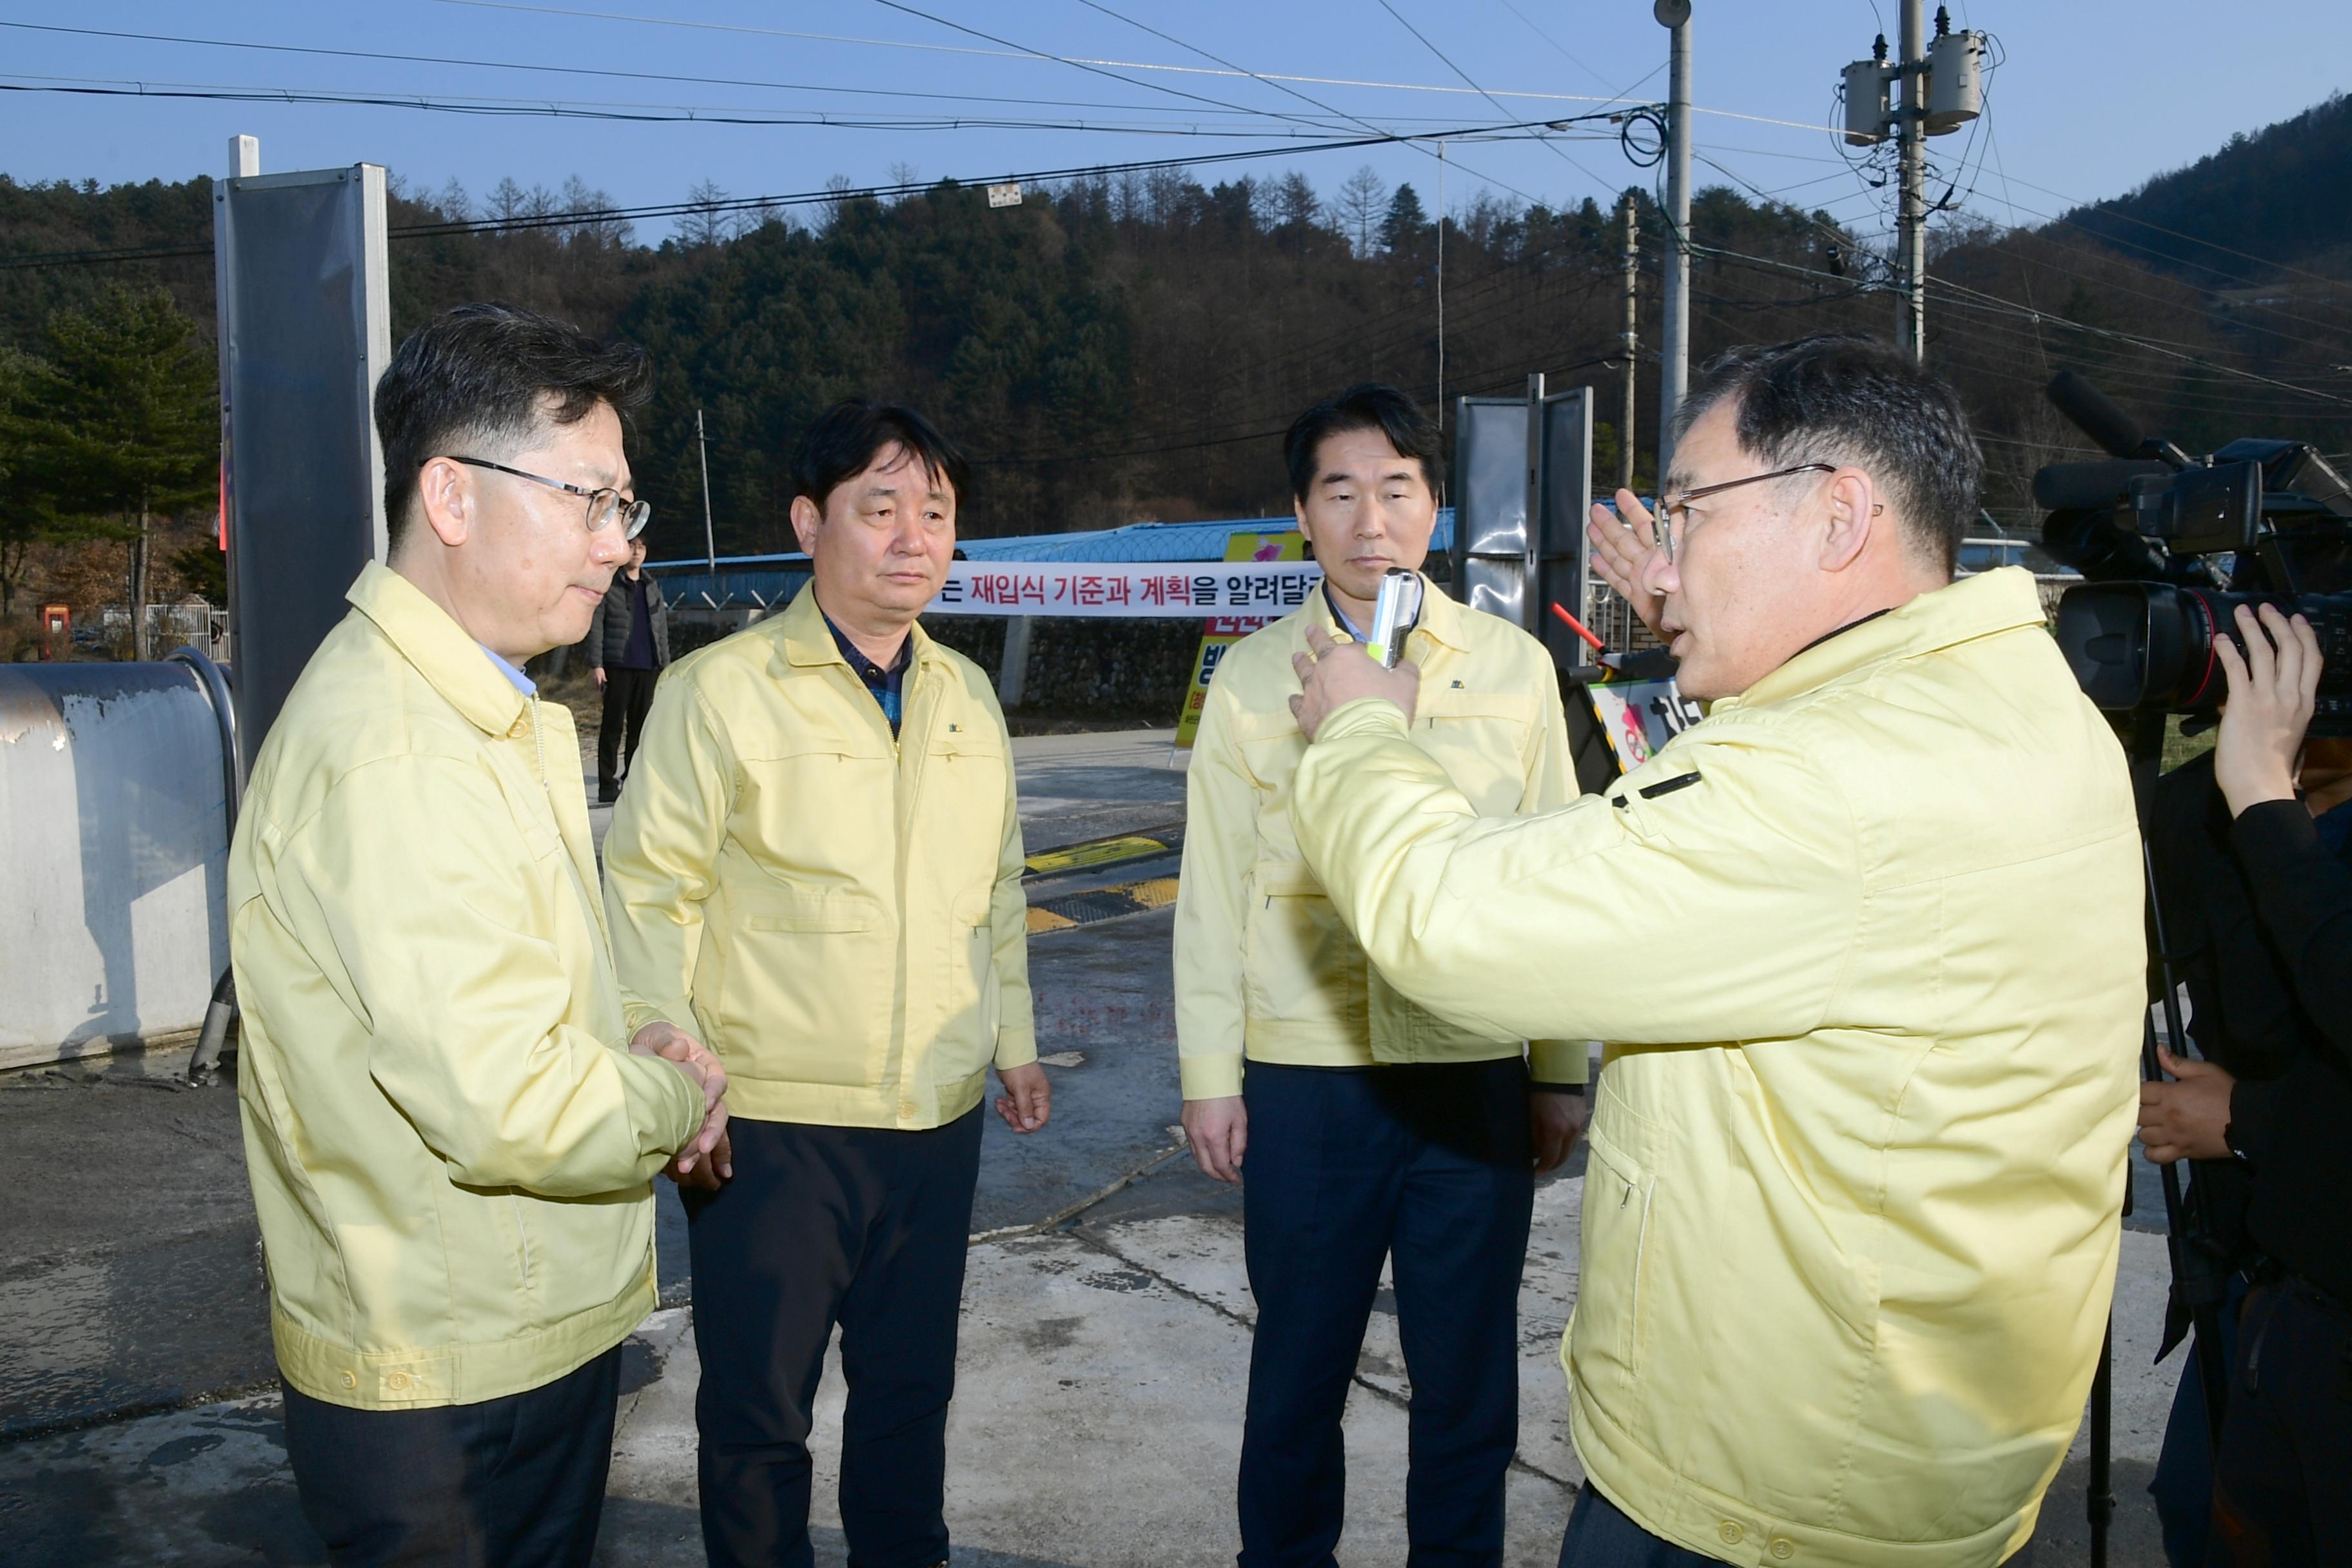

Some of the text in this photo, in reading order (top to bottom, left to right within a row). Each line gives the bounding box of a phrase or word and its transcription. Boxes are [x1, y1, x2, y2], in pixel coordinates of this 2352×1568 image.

[971, 574, 1045, 605] 재입식
[1054, 575, 1132, 606] 기준과
[1140, 575, 1219, 606] 계획을
[1227, 574, 1321, 606] 알려달
